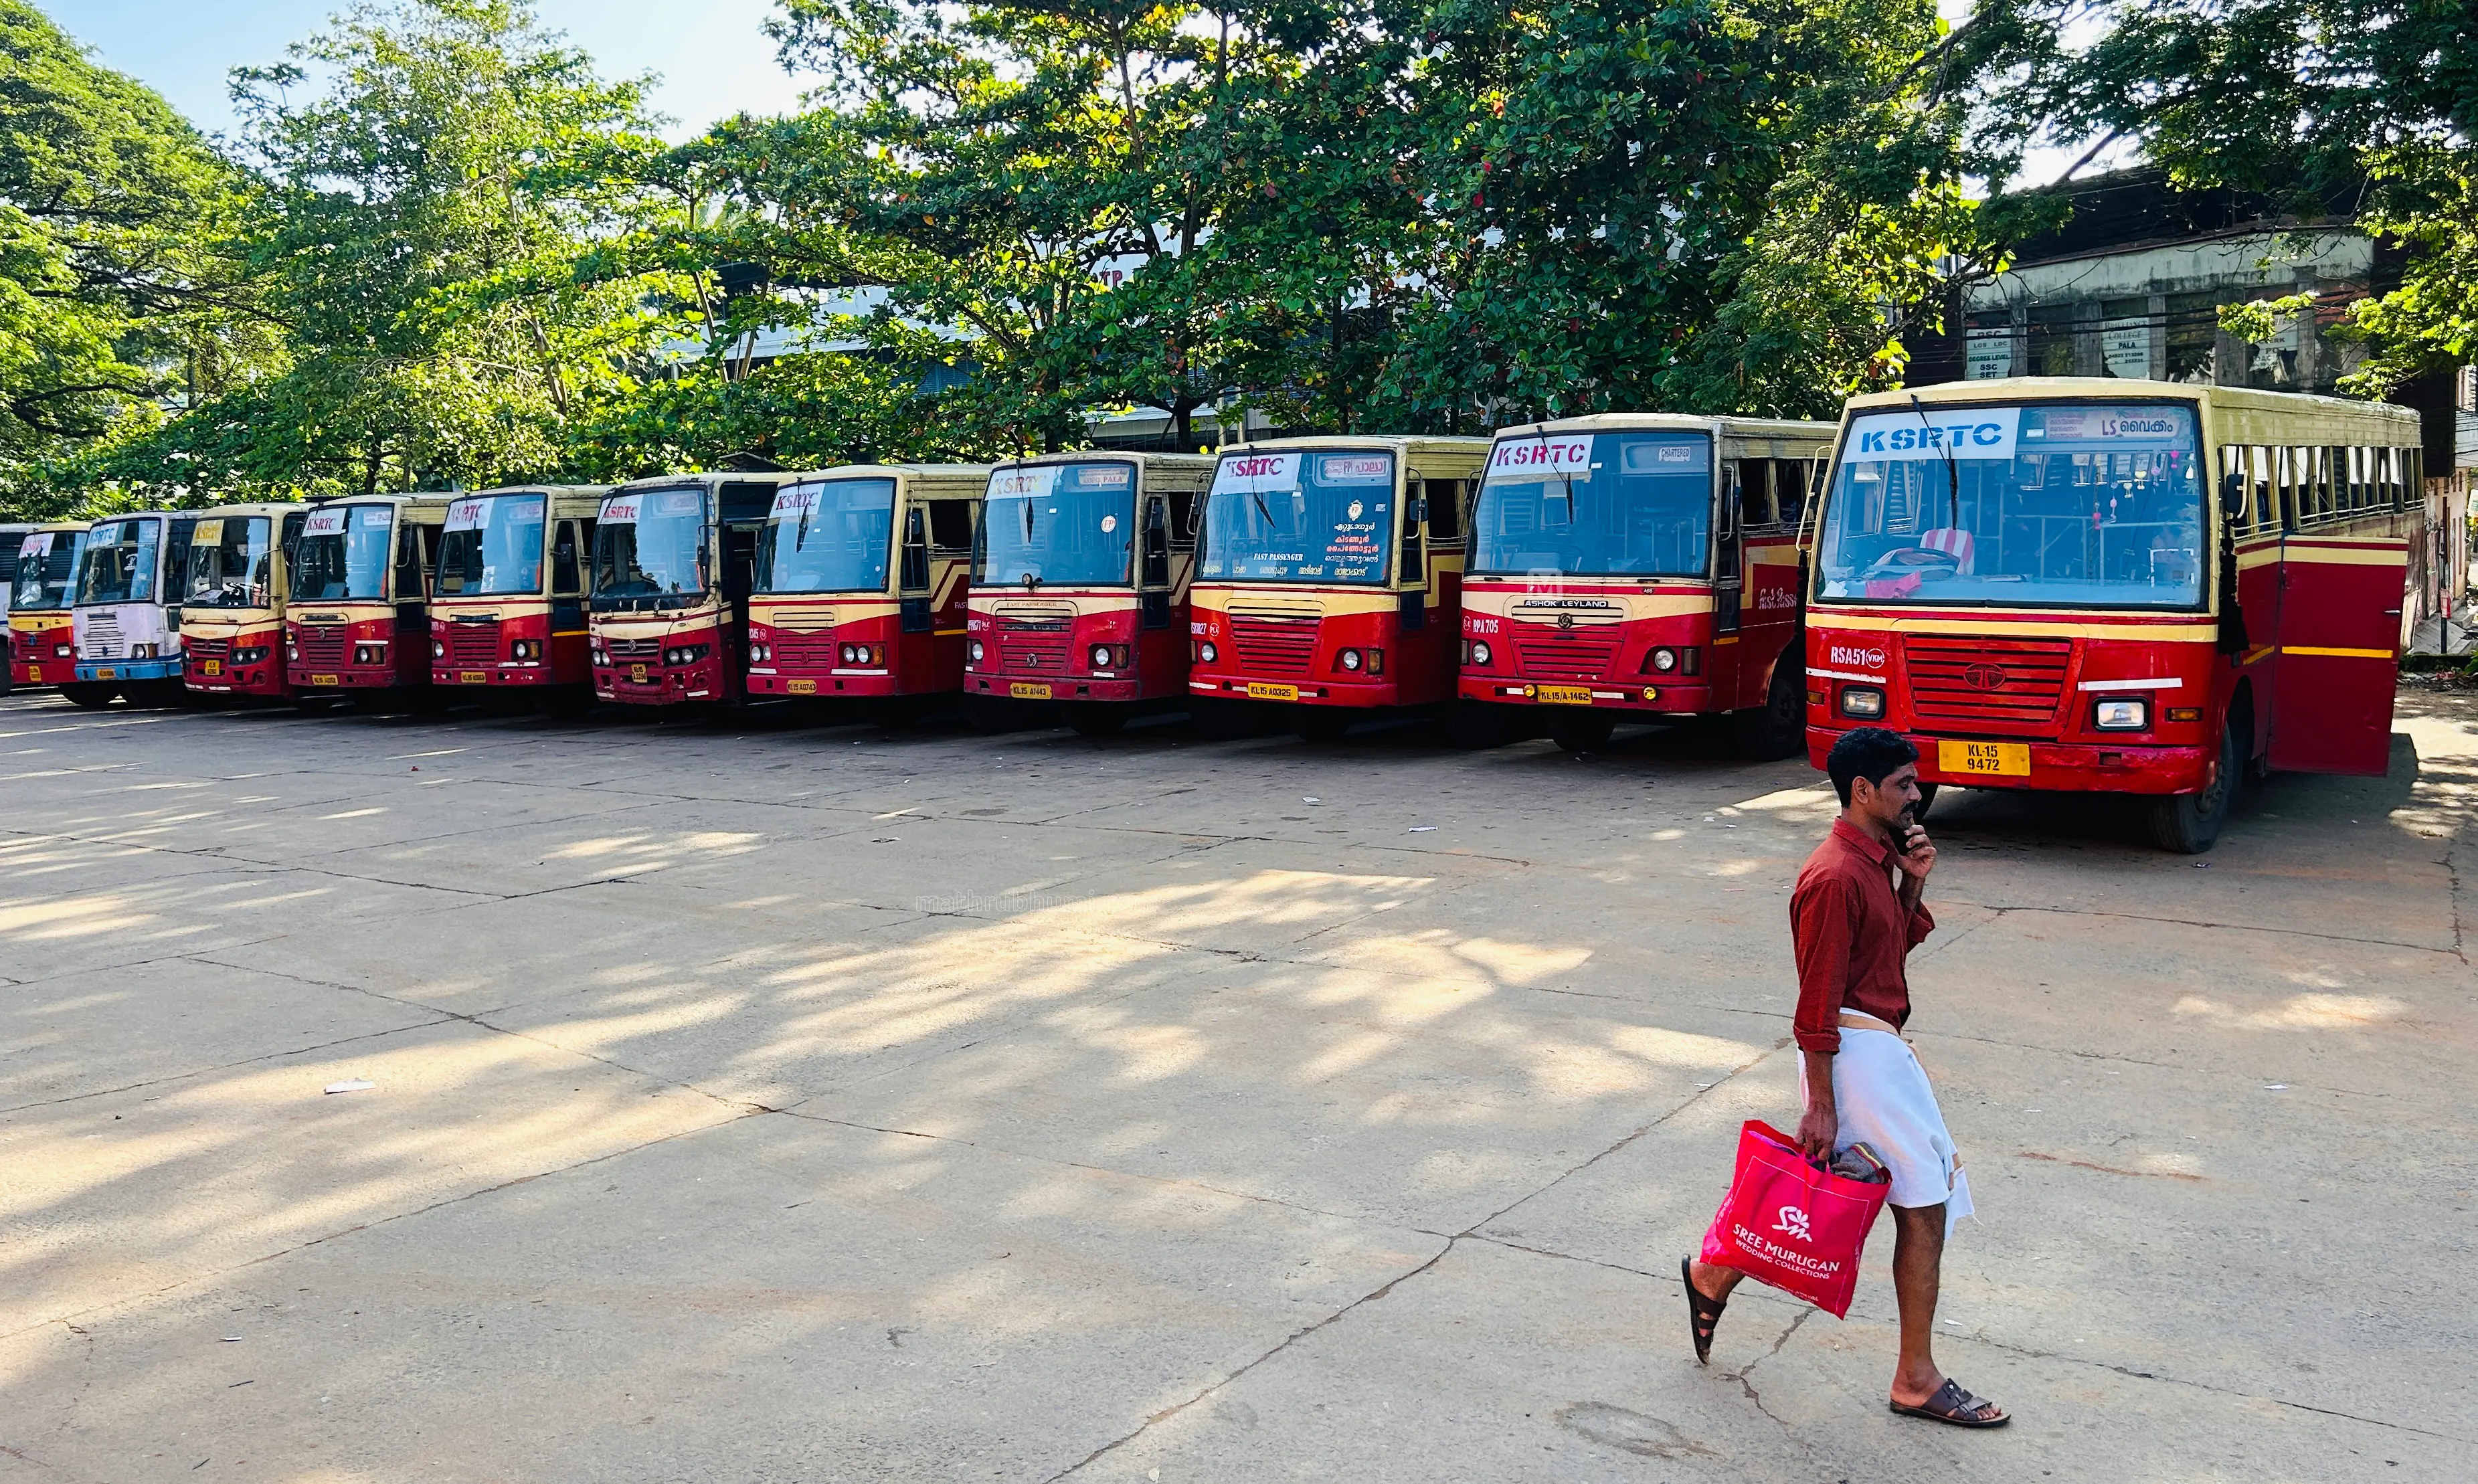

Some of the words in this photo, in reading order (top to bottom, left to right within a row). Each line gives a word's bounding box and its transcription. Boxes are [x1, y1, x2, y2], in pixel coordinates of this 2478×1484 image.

[2109, 331, 2141, 341] COLLEGE
[2102, 420, 2117, 436] LS
[1861, 423, 2002, 454] KSRTC
[1496, 444, 1585, 466] KSRTC
[1661, 448, 1690, 458] CHARTERED
[776, 492, 818, 511] KSRTC
[306, 518, 336, 531] KSRTC
[1104, 519, 1114, 529] FP
[1269, 553, 1304, 561] PASSENGER
[1562, 600, 1607, 608] LEYLAND
[1830, 646, 1866, 666] RSA51
[1868, 654, 1884, 663] VKM
[1030, 687, 1047, 696] A1443
[1269, 688, 1291, 697] A0325
[1967, 744, 1998, 757] KL-15
[1967, 758, 2000, 771] 9472
[1733, 1223, 1764, 1249] SREE
[1764, 1240, 1840, 1272] MURUGAN
[1735, 1238, 1773, 1263] WEDDING
[1774, 1259, 1830, 1279] COLLECTIONS
